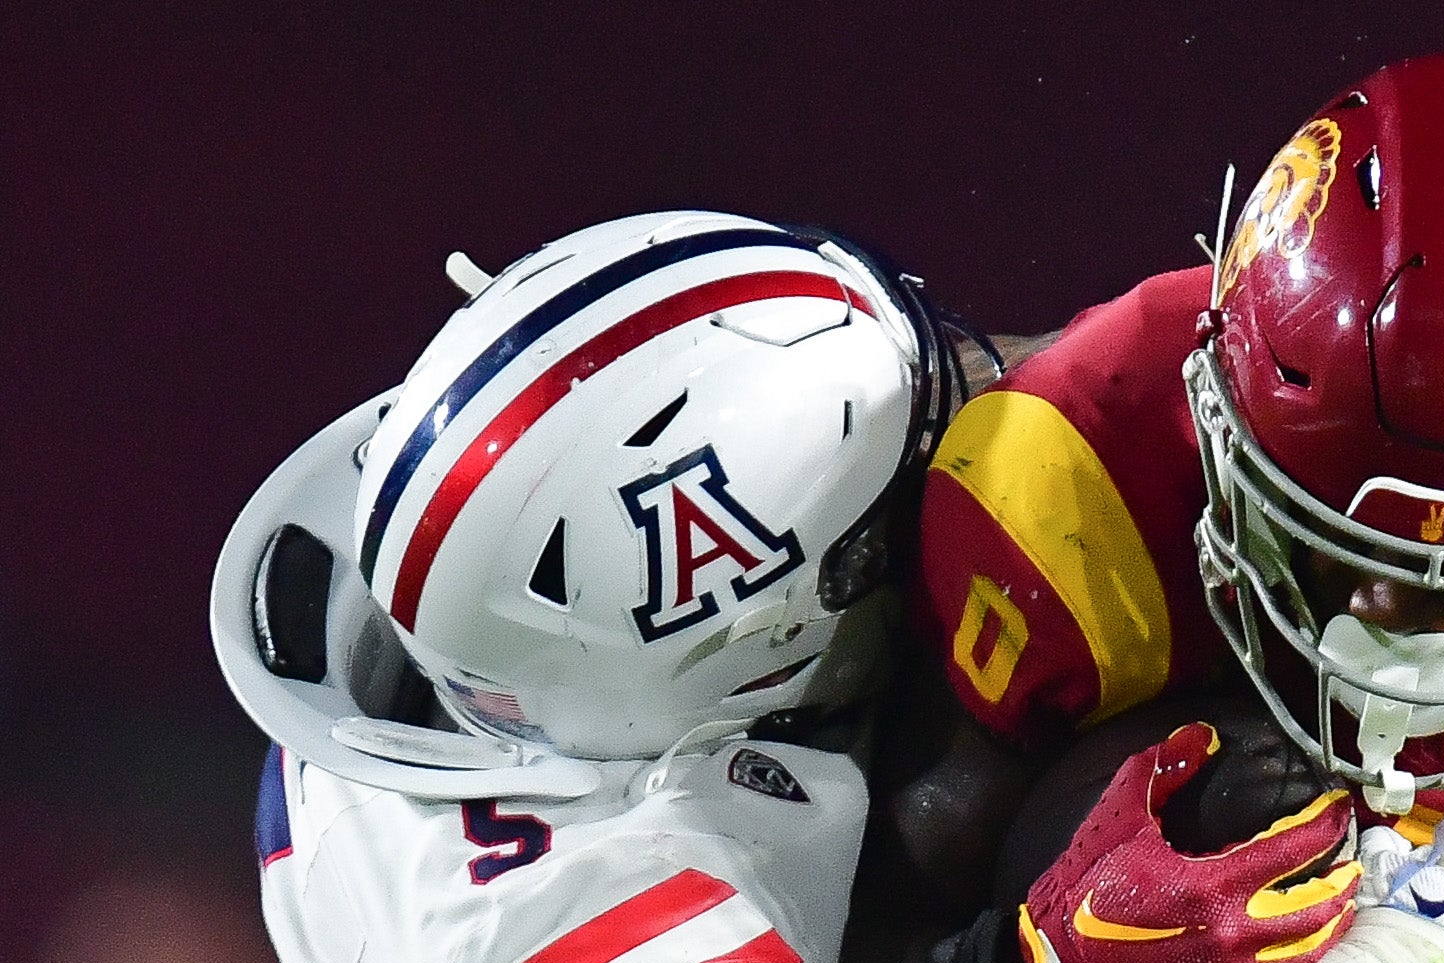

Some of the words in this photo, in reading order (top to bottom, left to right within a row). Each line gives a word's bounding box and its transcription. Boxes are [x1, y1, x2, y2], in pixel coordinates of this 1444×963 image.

[618, 442, 806, 644] A
[953, 573, 1030, 705] 0
[461, 798, 552, 885] 5
